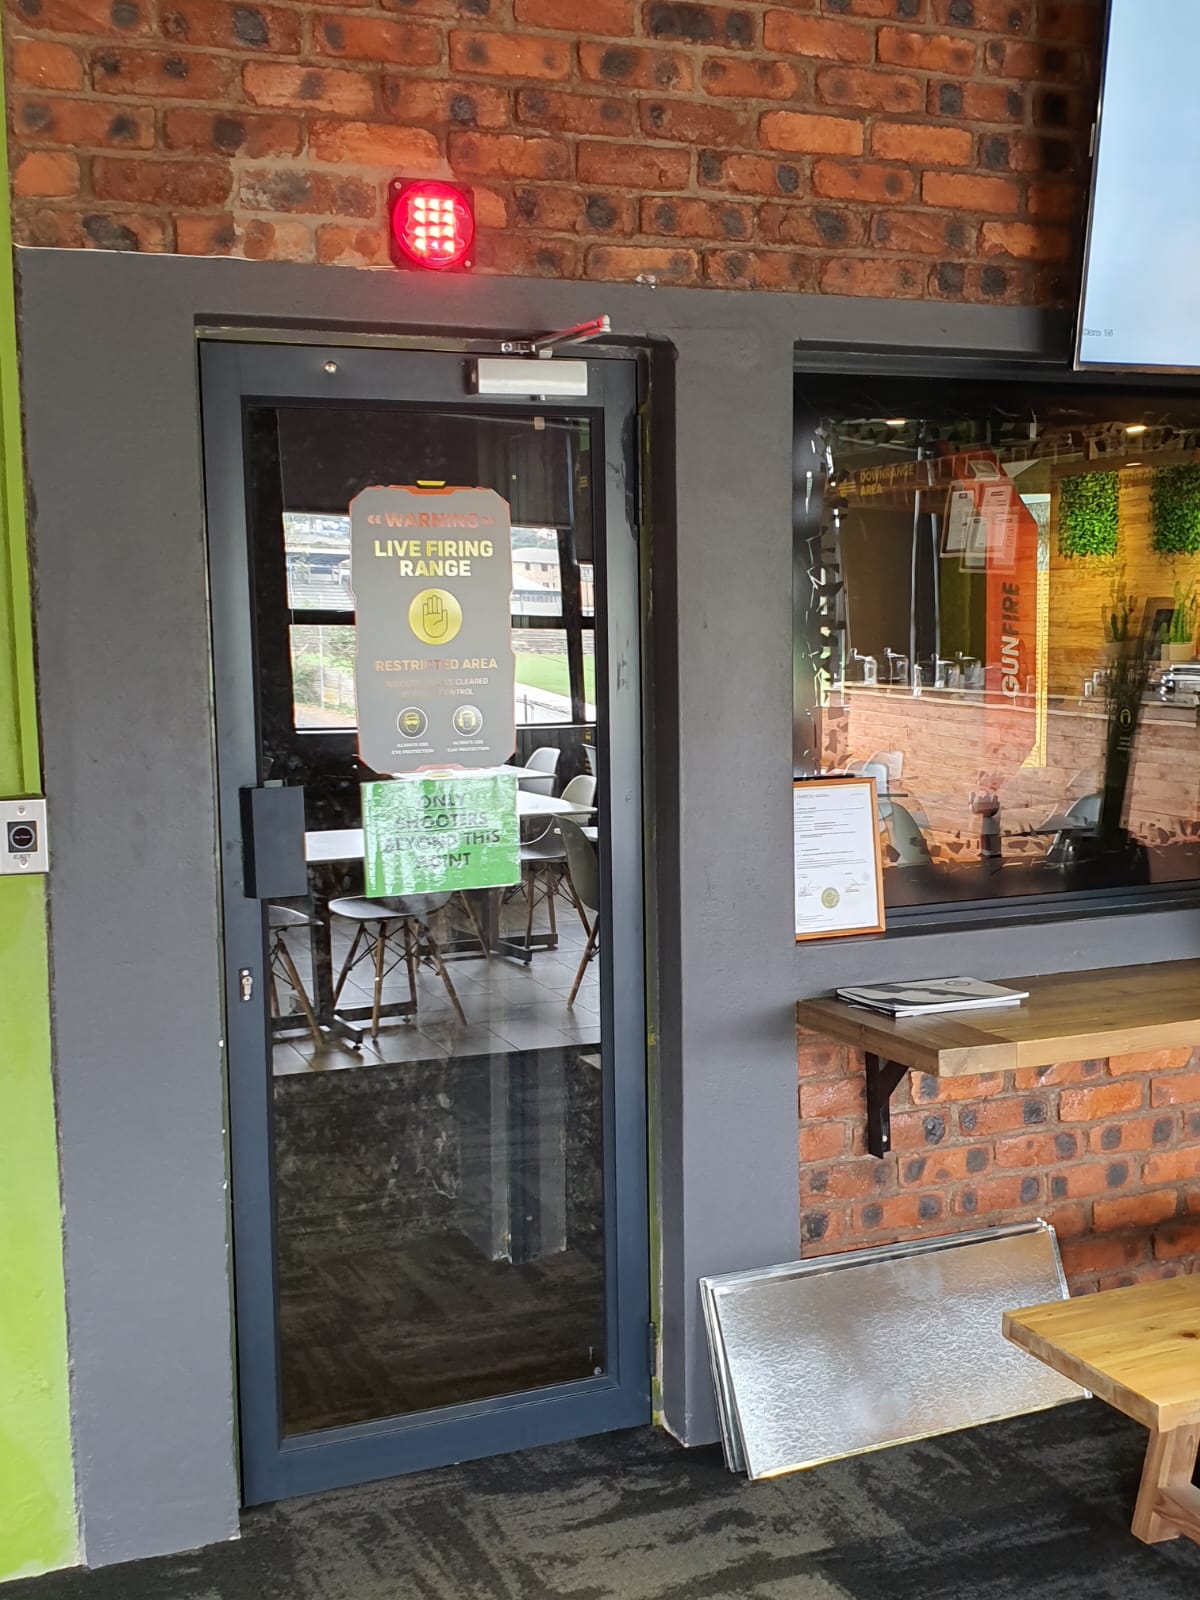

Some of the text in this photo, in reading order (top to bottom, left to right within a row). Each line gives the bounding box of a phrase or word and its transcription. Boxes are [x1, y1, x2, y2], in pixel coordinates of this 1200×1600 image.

[860, 463, 914, 482] DOWNRANGE
[860, 483, 882, 497] AREA
[384, 512, 479, 528] WARNING
[374, 540, 494, 557] LIVE FIRING
[400, 560, 472, 577] RANGE
[1001, 582, 1020, 698] GUNFIRE
[462, 657, 498, 670] AREA
[455, 677, 489, 686] CLEARED
[418, 793, 466, 809] ONLY
[395, 812, 489, 831] SHOOTERS
[383, 833, 459, 853] BEYOND
